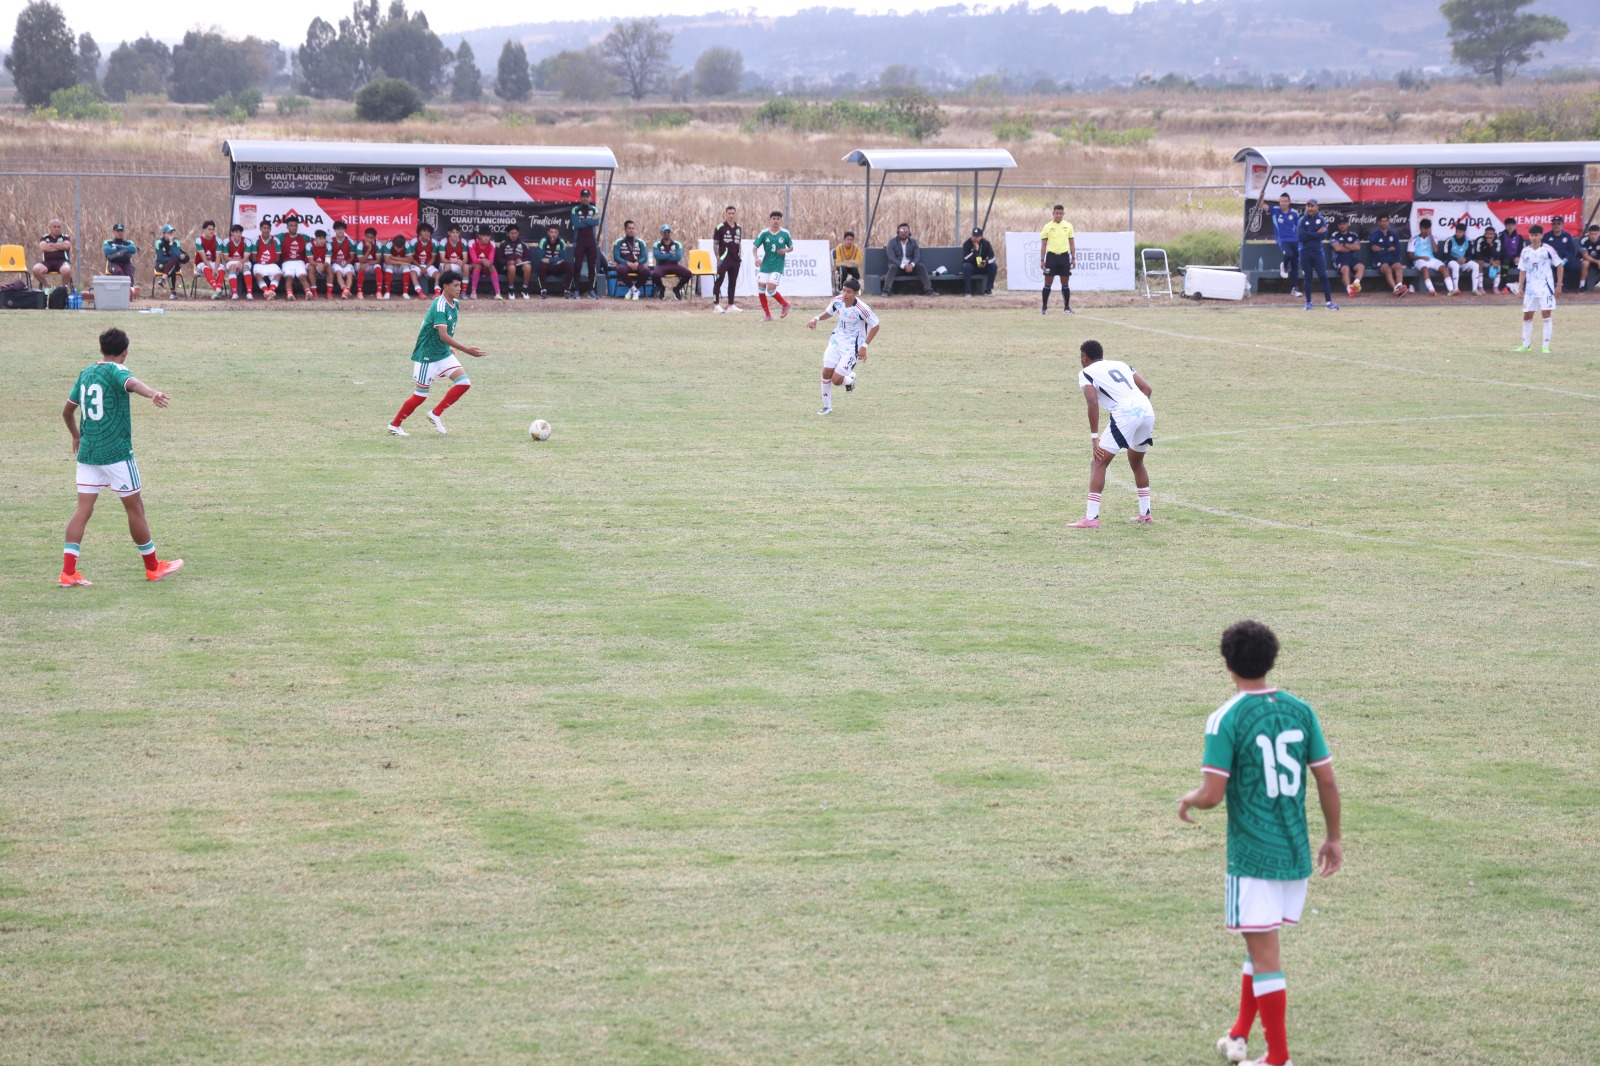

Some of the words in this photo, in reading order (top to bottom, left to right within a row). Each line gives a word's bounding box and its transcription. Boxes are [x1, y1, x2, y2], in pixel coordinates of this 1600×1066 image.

[300, 166, 342, 174] MUNICIPAL
[265, 173, 334, 181] CUAUTLANCINGO
[347, 172, 381, 184] Tradición
[384, 174, 389, 186] y
[391, 172, 415, 186] futuro
[448, 174, 507, 185] CALIDRA
[524, 176, 572, 186] SIEMPRE
[574, 176, 595, 187] AHÍ
[1271, 175, 1326, 186] CALIDRA
[1342, 177, 1387, 186] SIEMPRE
[1390, 175, 1409, 186] AHÍ
[1514, 172, 1546, 186] Tradición
[1548, 176, 1554, 186] y
[1556, 172, 1580, 186] futuro
[271, 180, 295, 189] 2024
[305, 181, 328, 190] 2027
[341, 215, 390, 225] SIEMPRE
[392, 213, 412, 224] AHÍ
[528, 215, 562, 228] Tradición
[564, 218, 570, 229] y
[1510, 214, 1553, 225] IEMPRE
[771, 244, 776, 252] 3
[1076, 252, 1120, 261] BIERNO
[785, 259, 817, 267] ERNO
[1077, 262, 1120, 270] NICIPAL
[1547, 295, 1553, 304] 19
[1108, 369, 1133, 389] 9
[80, 384, 104, 420] 13
[1256, 729, 1304, 798] 15
